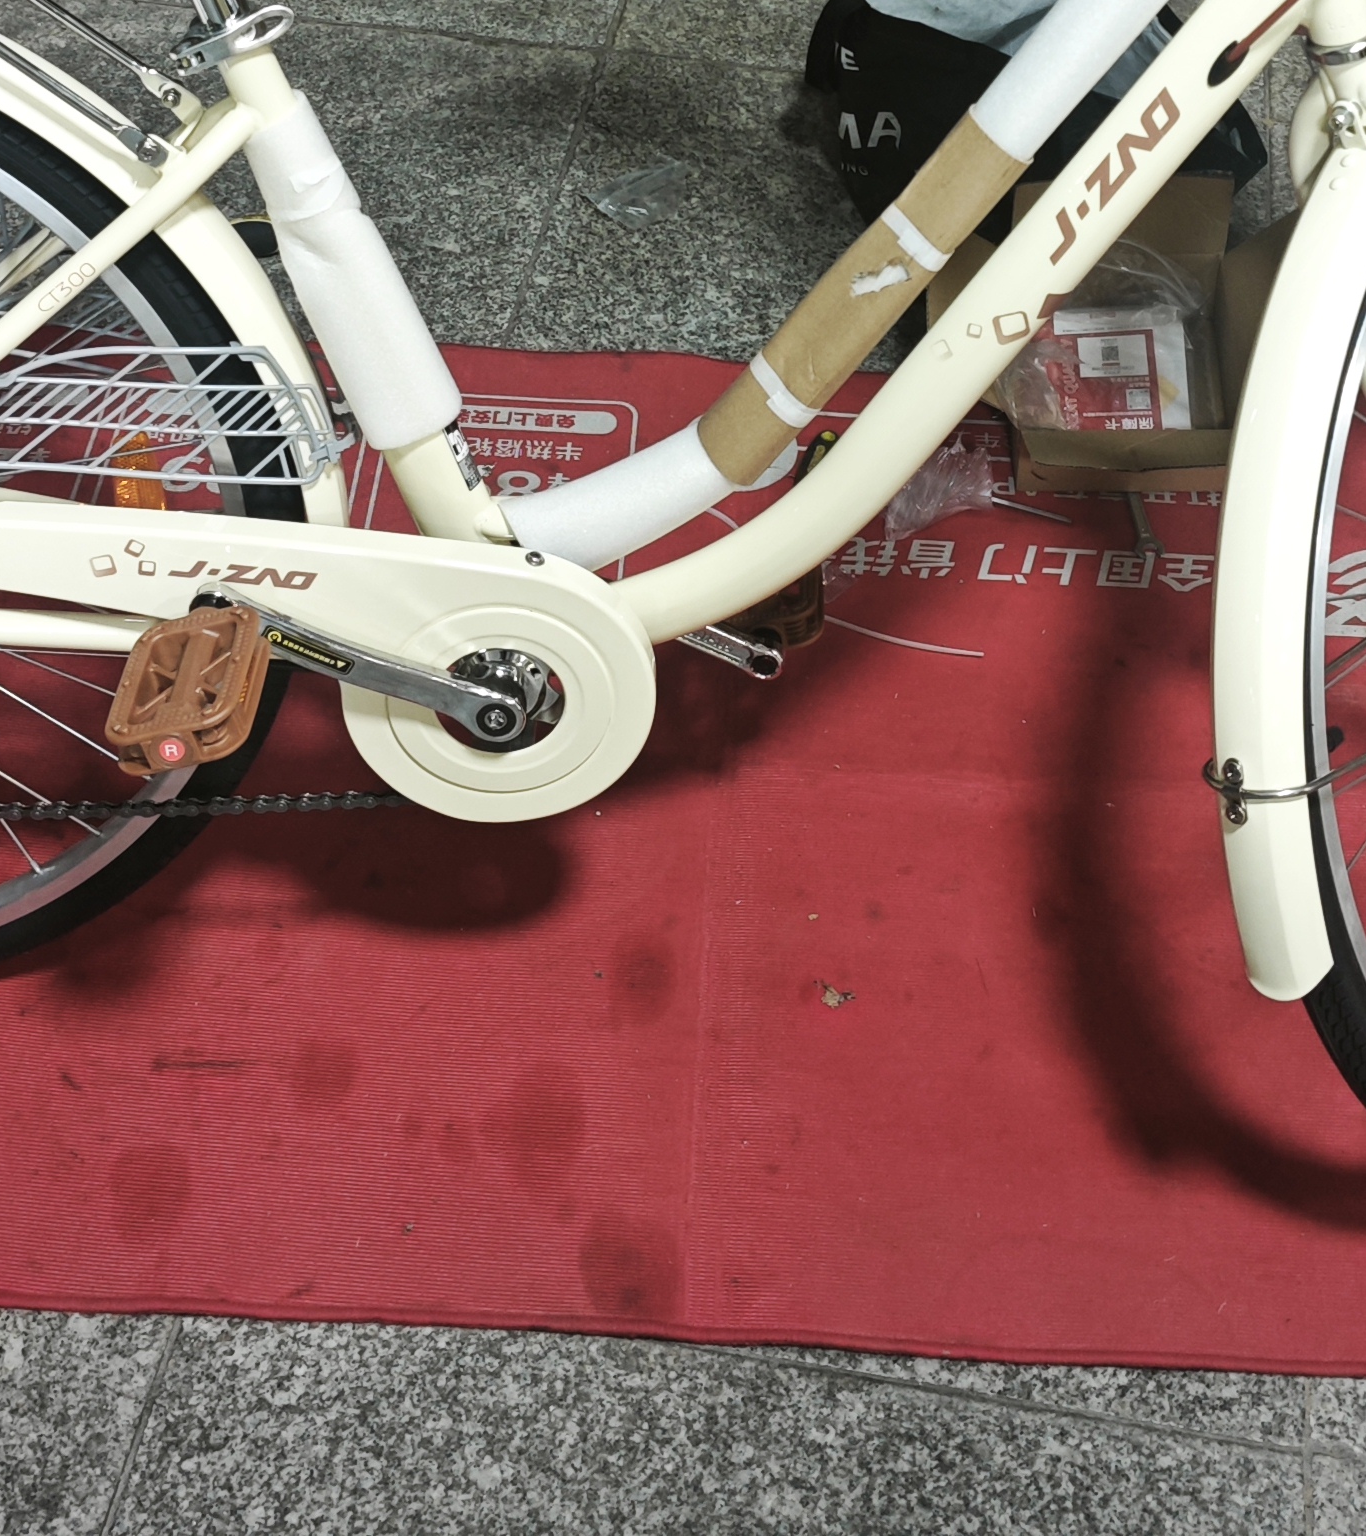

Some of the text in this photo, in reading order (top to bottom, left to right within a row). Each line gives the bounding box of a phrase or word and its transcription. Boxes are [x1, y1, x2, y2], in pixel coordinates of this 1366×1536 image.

[37, 261, 97, 313] CT300
[466, 436, 584, 462] 半热熔轮
[821, 536, 1216, 594] 全国上门 省钱
